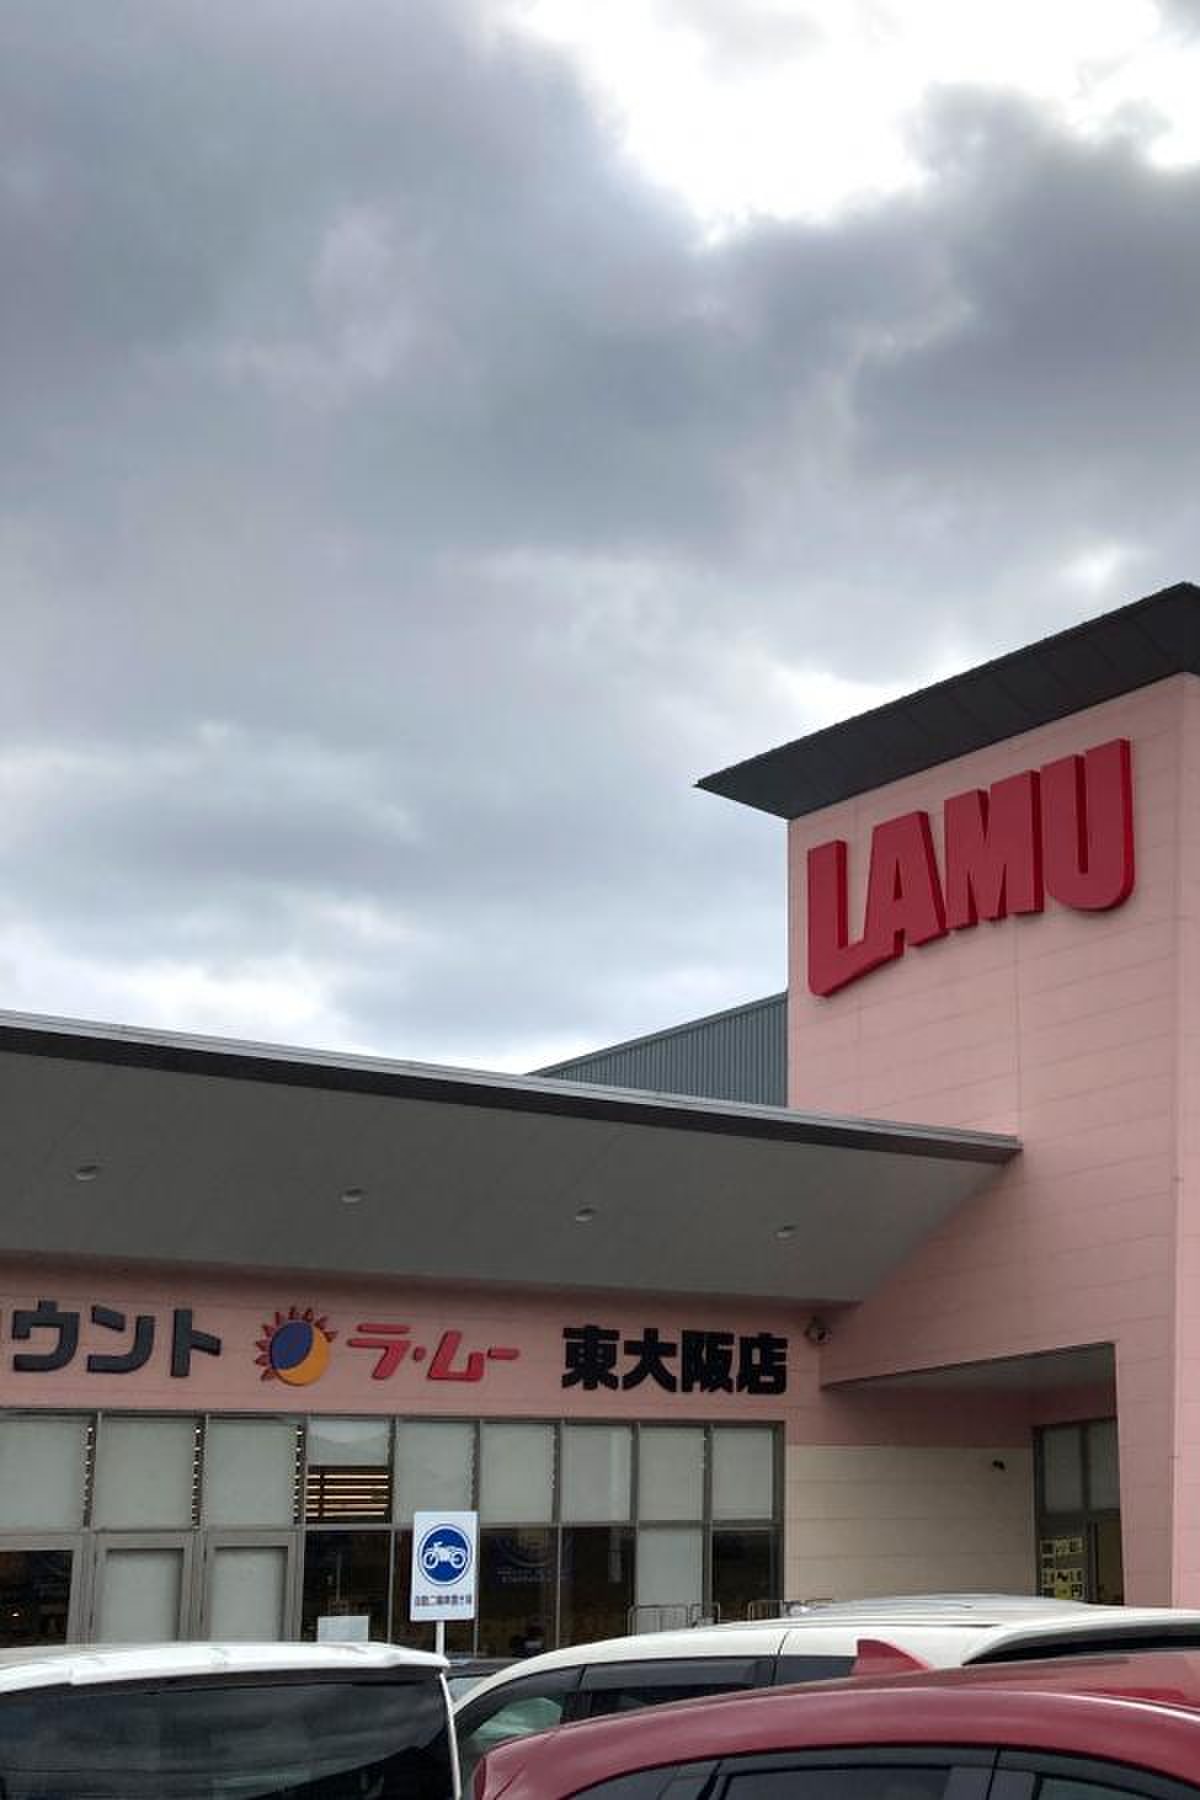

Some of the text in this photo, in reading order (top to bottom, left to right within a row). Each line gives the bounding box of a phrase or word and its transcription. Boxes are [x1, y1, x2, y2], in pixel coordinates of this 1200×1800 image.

[807, 738, 1136, 998] LAMU
[561, 1325, 789, 1395] 東大阪店
